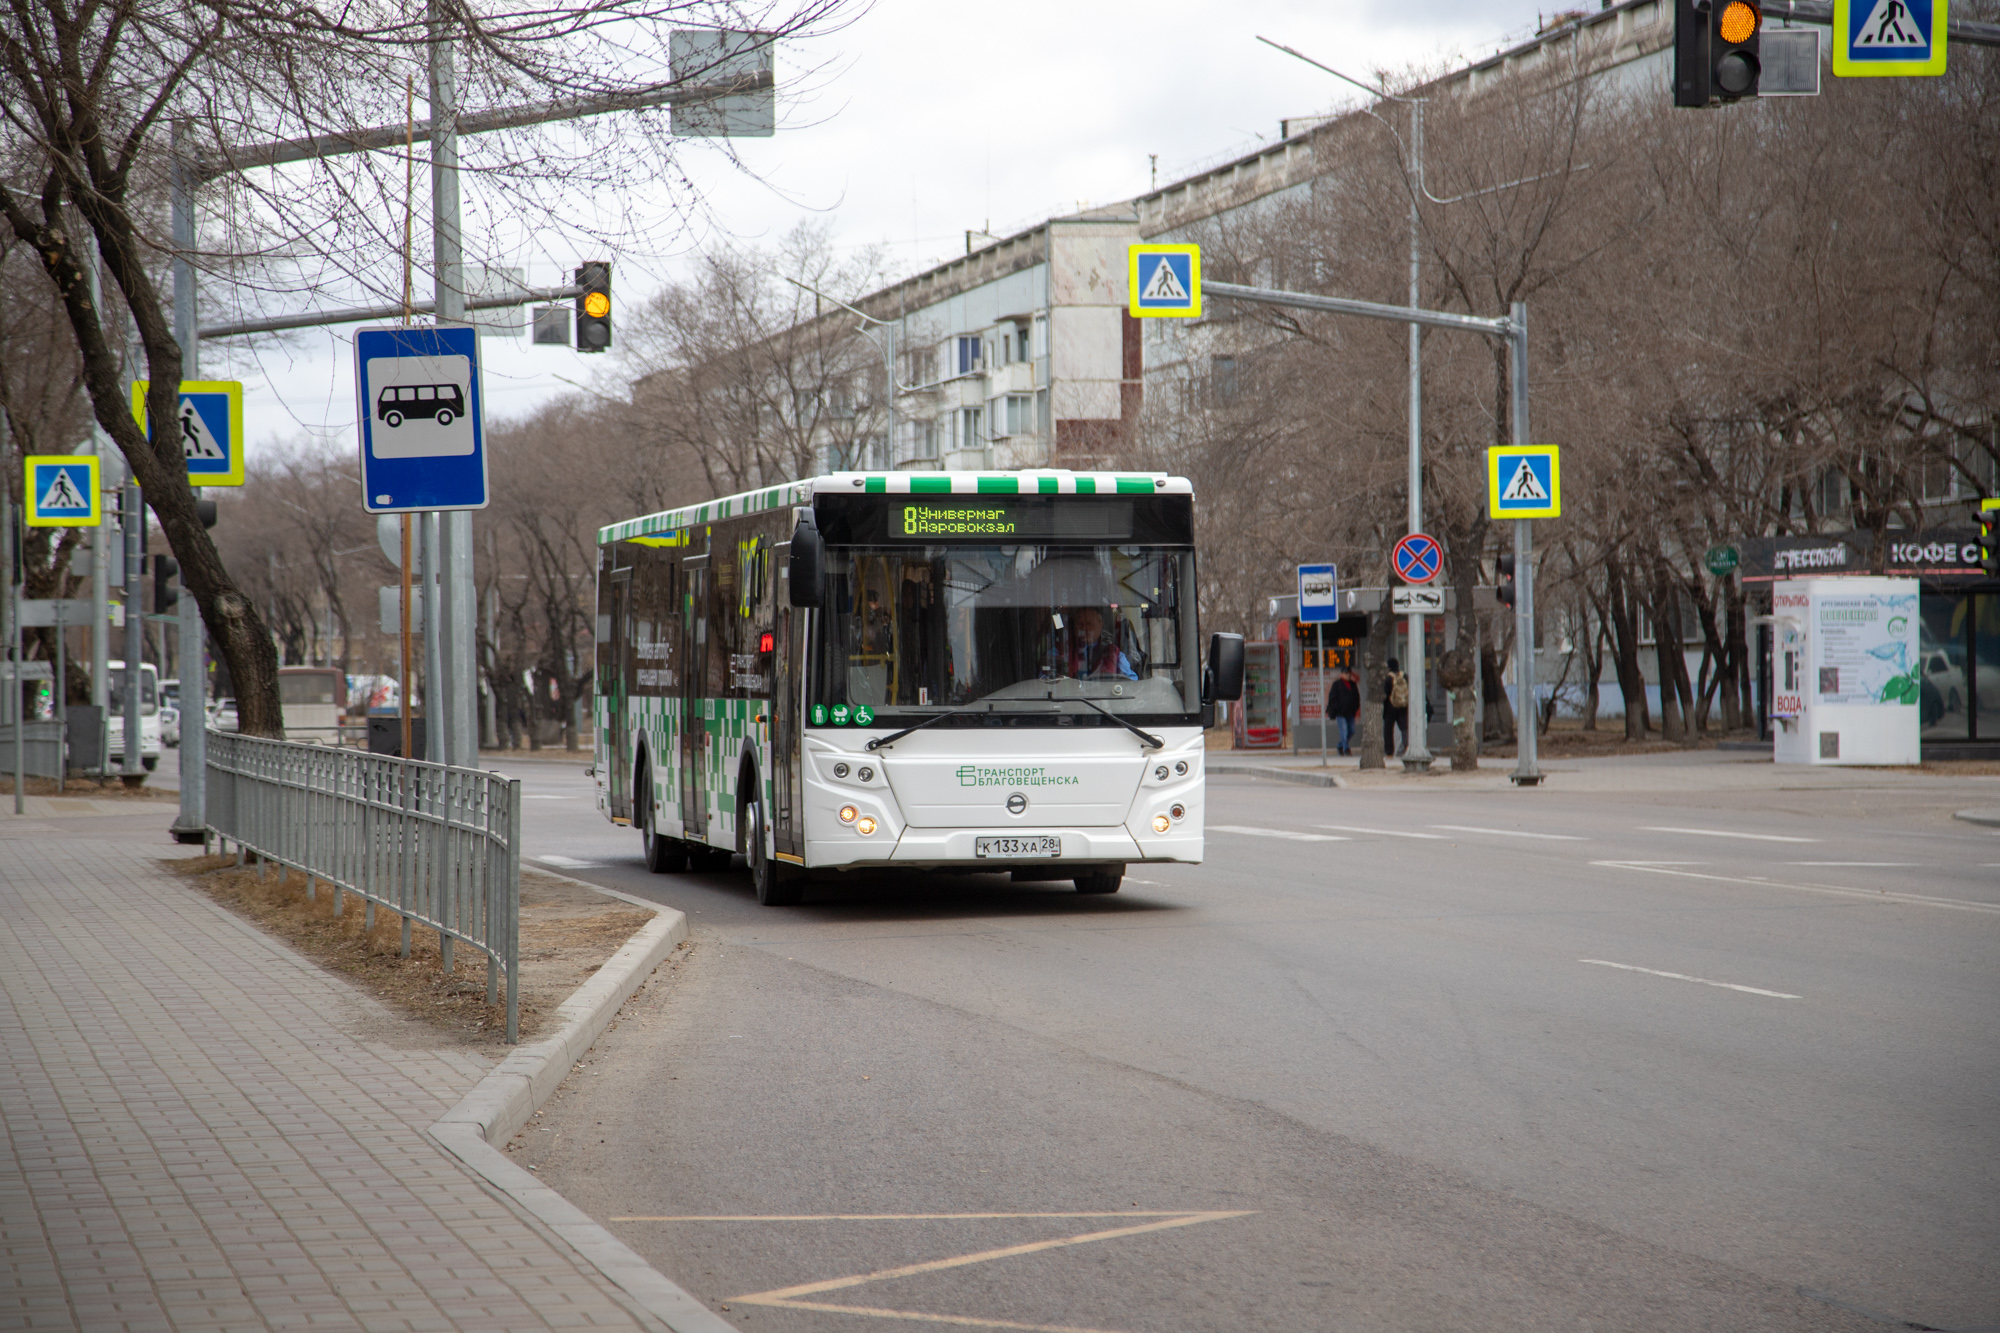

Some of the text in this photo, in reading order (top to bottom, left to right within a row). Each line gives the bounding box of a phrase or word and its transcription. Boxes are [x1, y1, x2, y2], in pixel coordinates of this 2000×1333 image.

[904, 507, 917, 534] 8
[918, 507, 1005, 521] Универмаг
[918, 520, 1015, 534] Аэровокзал
[1892, 542, 1979, 565] КОФЕ С
[1775, 594, 1809, 609] ОТКРЫЛИСЬ
[1777, 695, 1802, 714] ВОДА
[977, 767, 1045, 777] ТРАНСПОРТ
[978, 776, 1079, 786] БЛАГОВЕЩЕНСКА
[1041, 838, 1055, 849] 28
